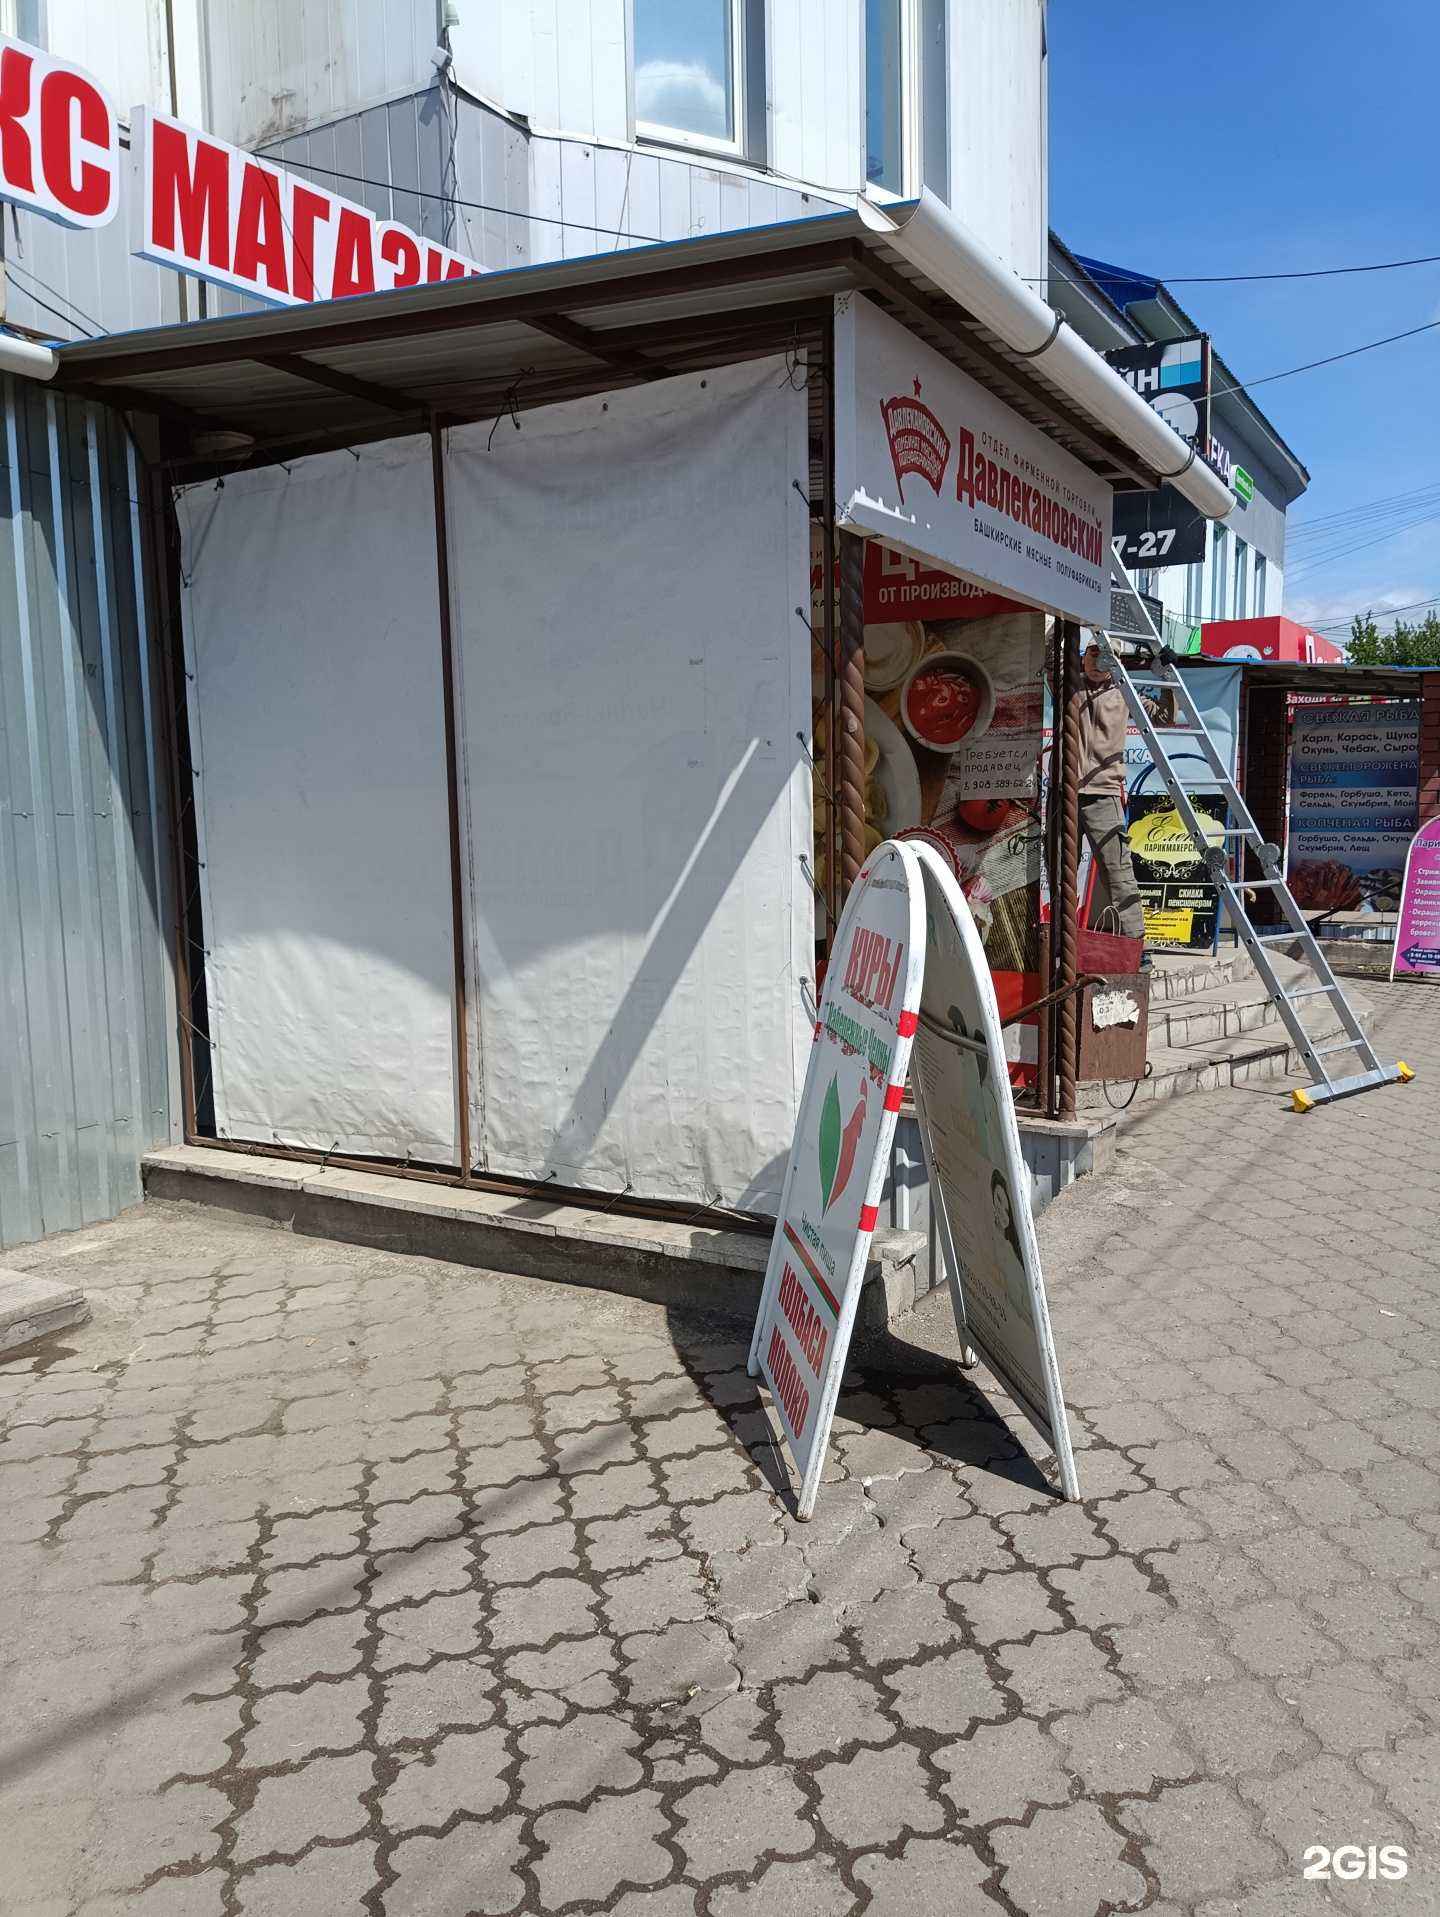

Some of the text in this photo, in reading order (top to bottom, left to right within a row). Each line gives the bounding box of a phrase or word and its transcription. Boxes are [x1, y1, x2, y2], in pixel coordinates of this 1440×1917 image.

[956, 426, 1103, 567] Давлекановский
[973, 518, 1022, 554] БАШКИРСКИЕ
[1026, 546, 1052, 569] МЯСНЫЕ
[879, 581, 988, 604] ОТ ПРОИЗВОД
[1383, 743, 1419, 755] Сыро
[1178, 888, 1204, 898] СКИДКА
[843, 926, 904, 1011] КУРЫ
[778, 1260, 828, 1380] КОЛБАСА
[767, 1322, 810, 1440] МОЛОКО
